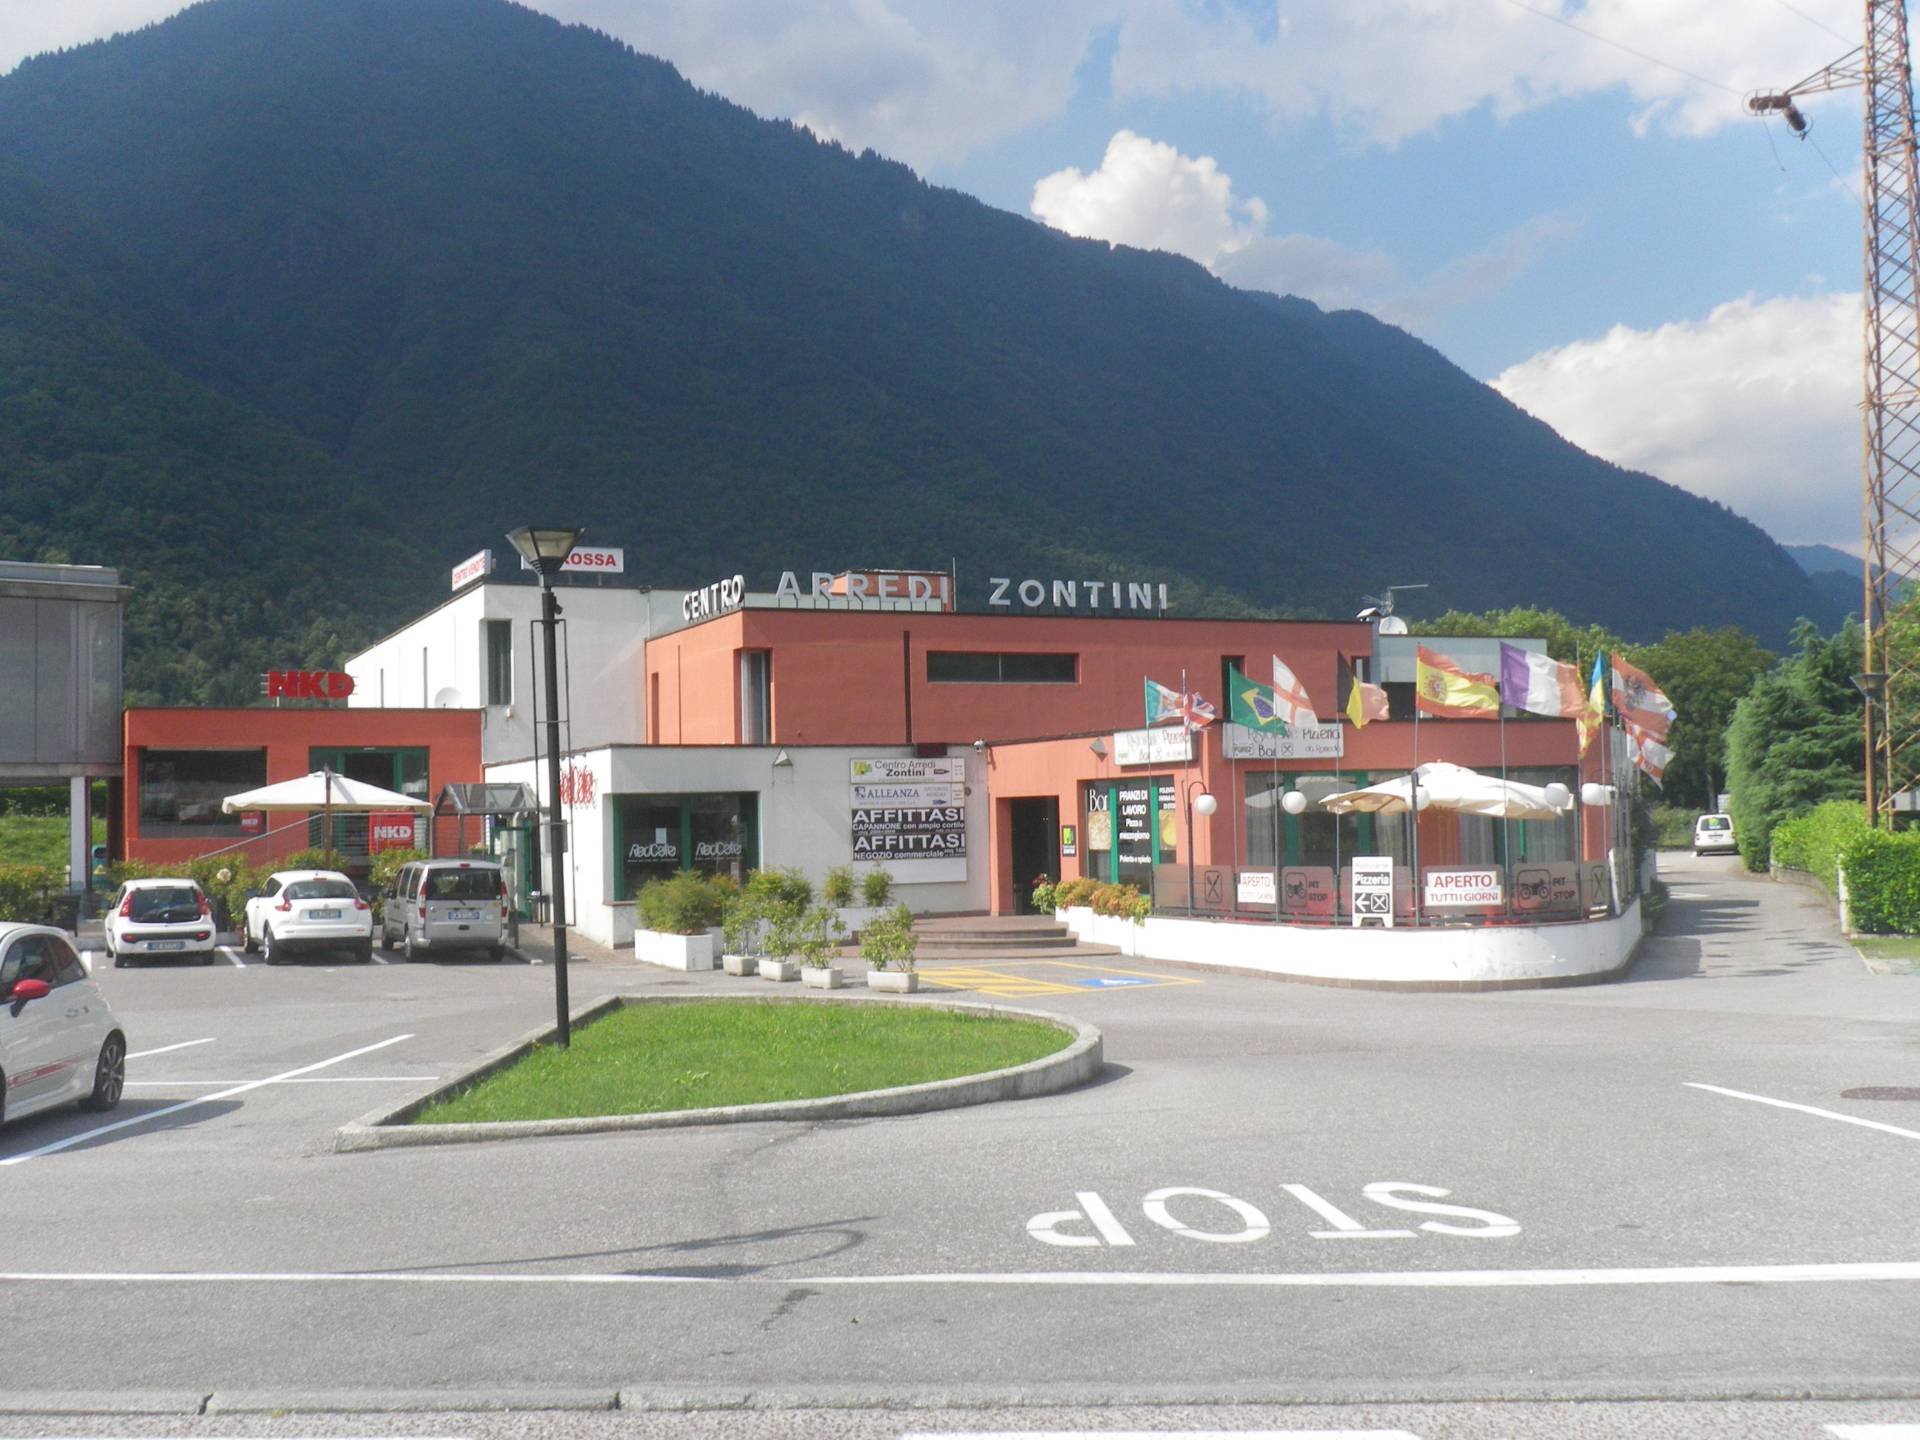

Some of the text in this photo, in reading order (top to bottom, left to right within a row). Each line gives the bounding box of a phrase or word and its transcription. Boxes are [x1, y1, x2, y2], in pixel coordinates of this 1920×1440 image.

[564, 552, 617, 567] OSSA
[776, 571, 1168, 610] ARREDI ZONTINI
[683, 574, 745, 621] CENTRO
[266, 671, 356, 699] NKD
[875, 759, 936, 769] Centro Arredi
[886, 768, 926, 777] Zontini
[867, 788, 920, 799] ALLEANZA
[1089, 788, 1108, 811] Bar
[853, 808, 964, 823] AFFITTASI
[1122, 804, 1147, 815] LAVORO
[374, 825, 413, 840] NKD
[853, 822, 901, 831] CAPANNONE
[919, 822, 941, 831] ampio
[942, 821, 965, 829] cortile
[854, 833, 966, 851] AFFITTASI
[854, 850, 893, 860] NEGOZIO
[894, 849, 944, 859] commerciale
[1242, 875, 1271, 888] APERTO
[1354, 873, 1390, 885] Pizzeria
[1434, 874, 1493, 888] APERTO
[1431, 892, 1457, 902] TUTTI
[1464, 891, 1498, 902] GIORNI
[1553, 890, 1576, 901] STOP
[1026, 1181, 1522, 1247] STOP
